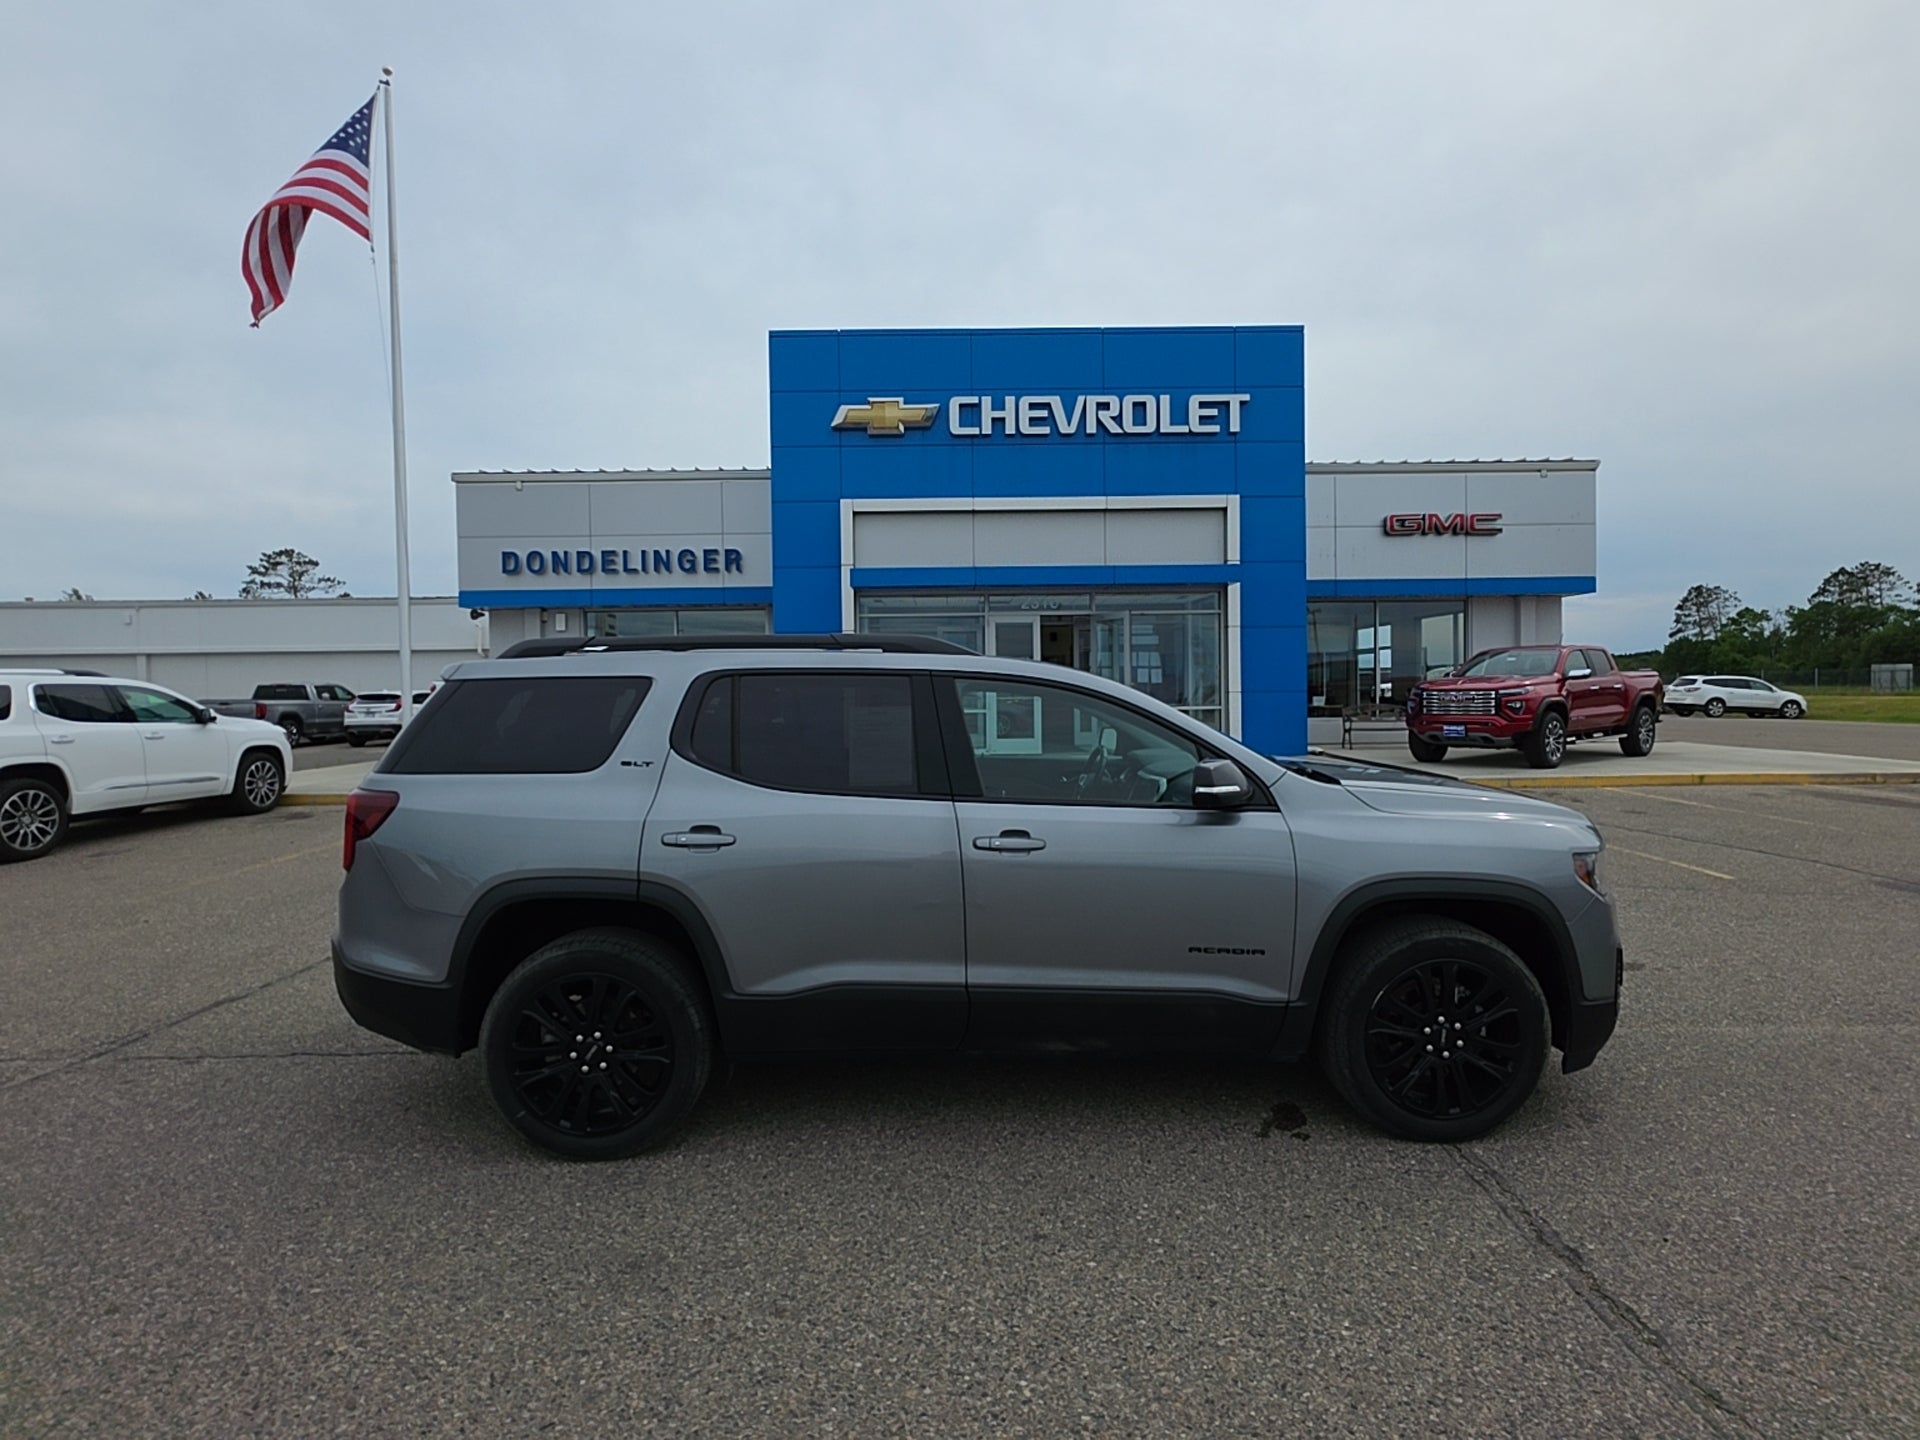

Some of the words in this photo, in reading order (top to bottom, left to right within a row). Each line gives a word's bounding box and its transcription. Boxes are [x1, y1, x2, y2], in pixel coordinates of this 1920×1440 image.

[948, 393, 1251, 436] CHEVROLET
[1384, 512, 1503, 536] GMC
[501, 548, 743, 575] DONDELINGER
[1188, 946, 1266, 956] ACADIA
